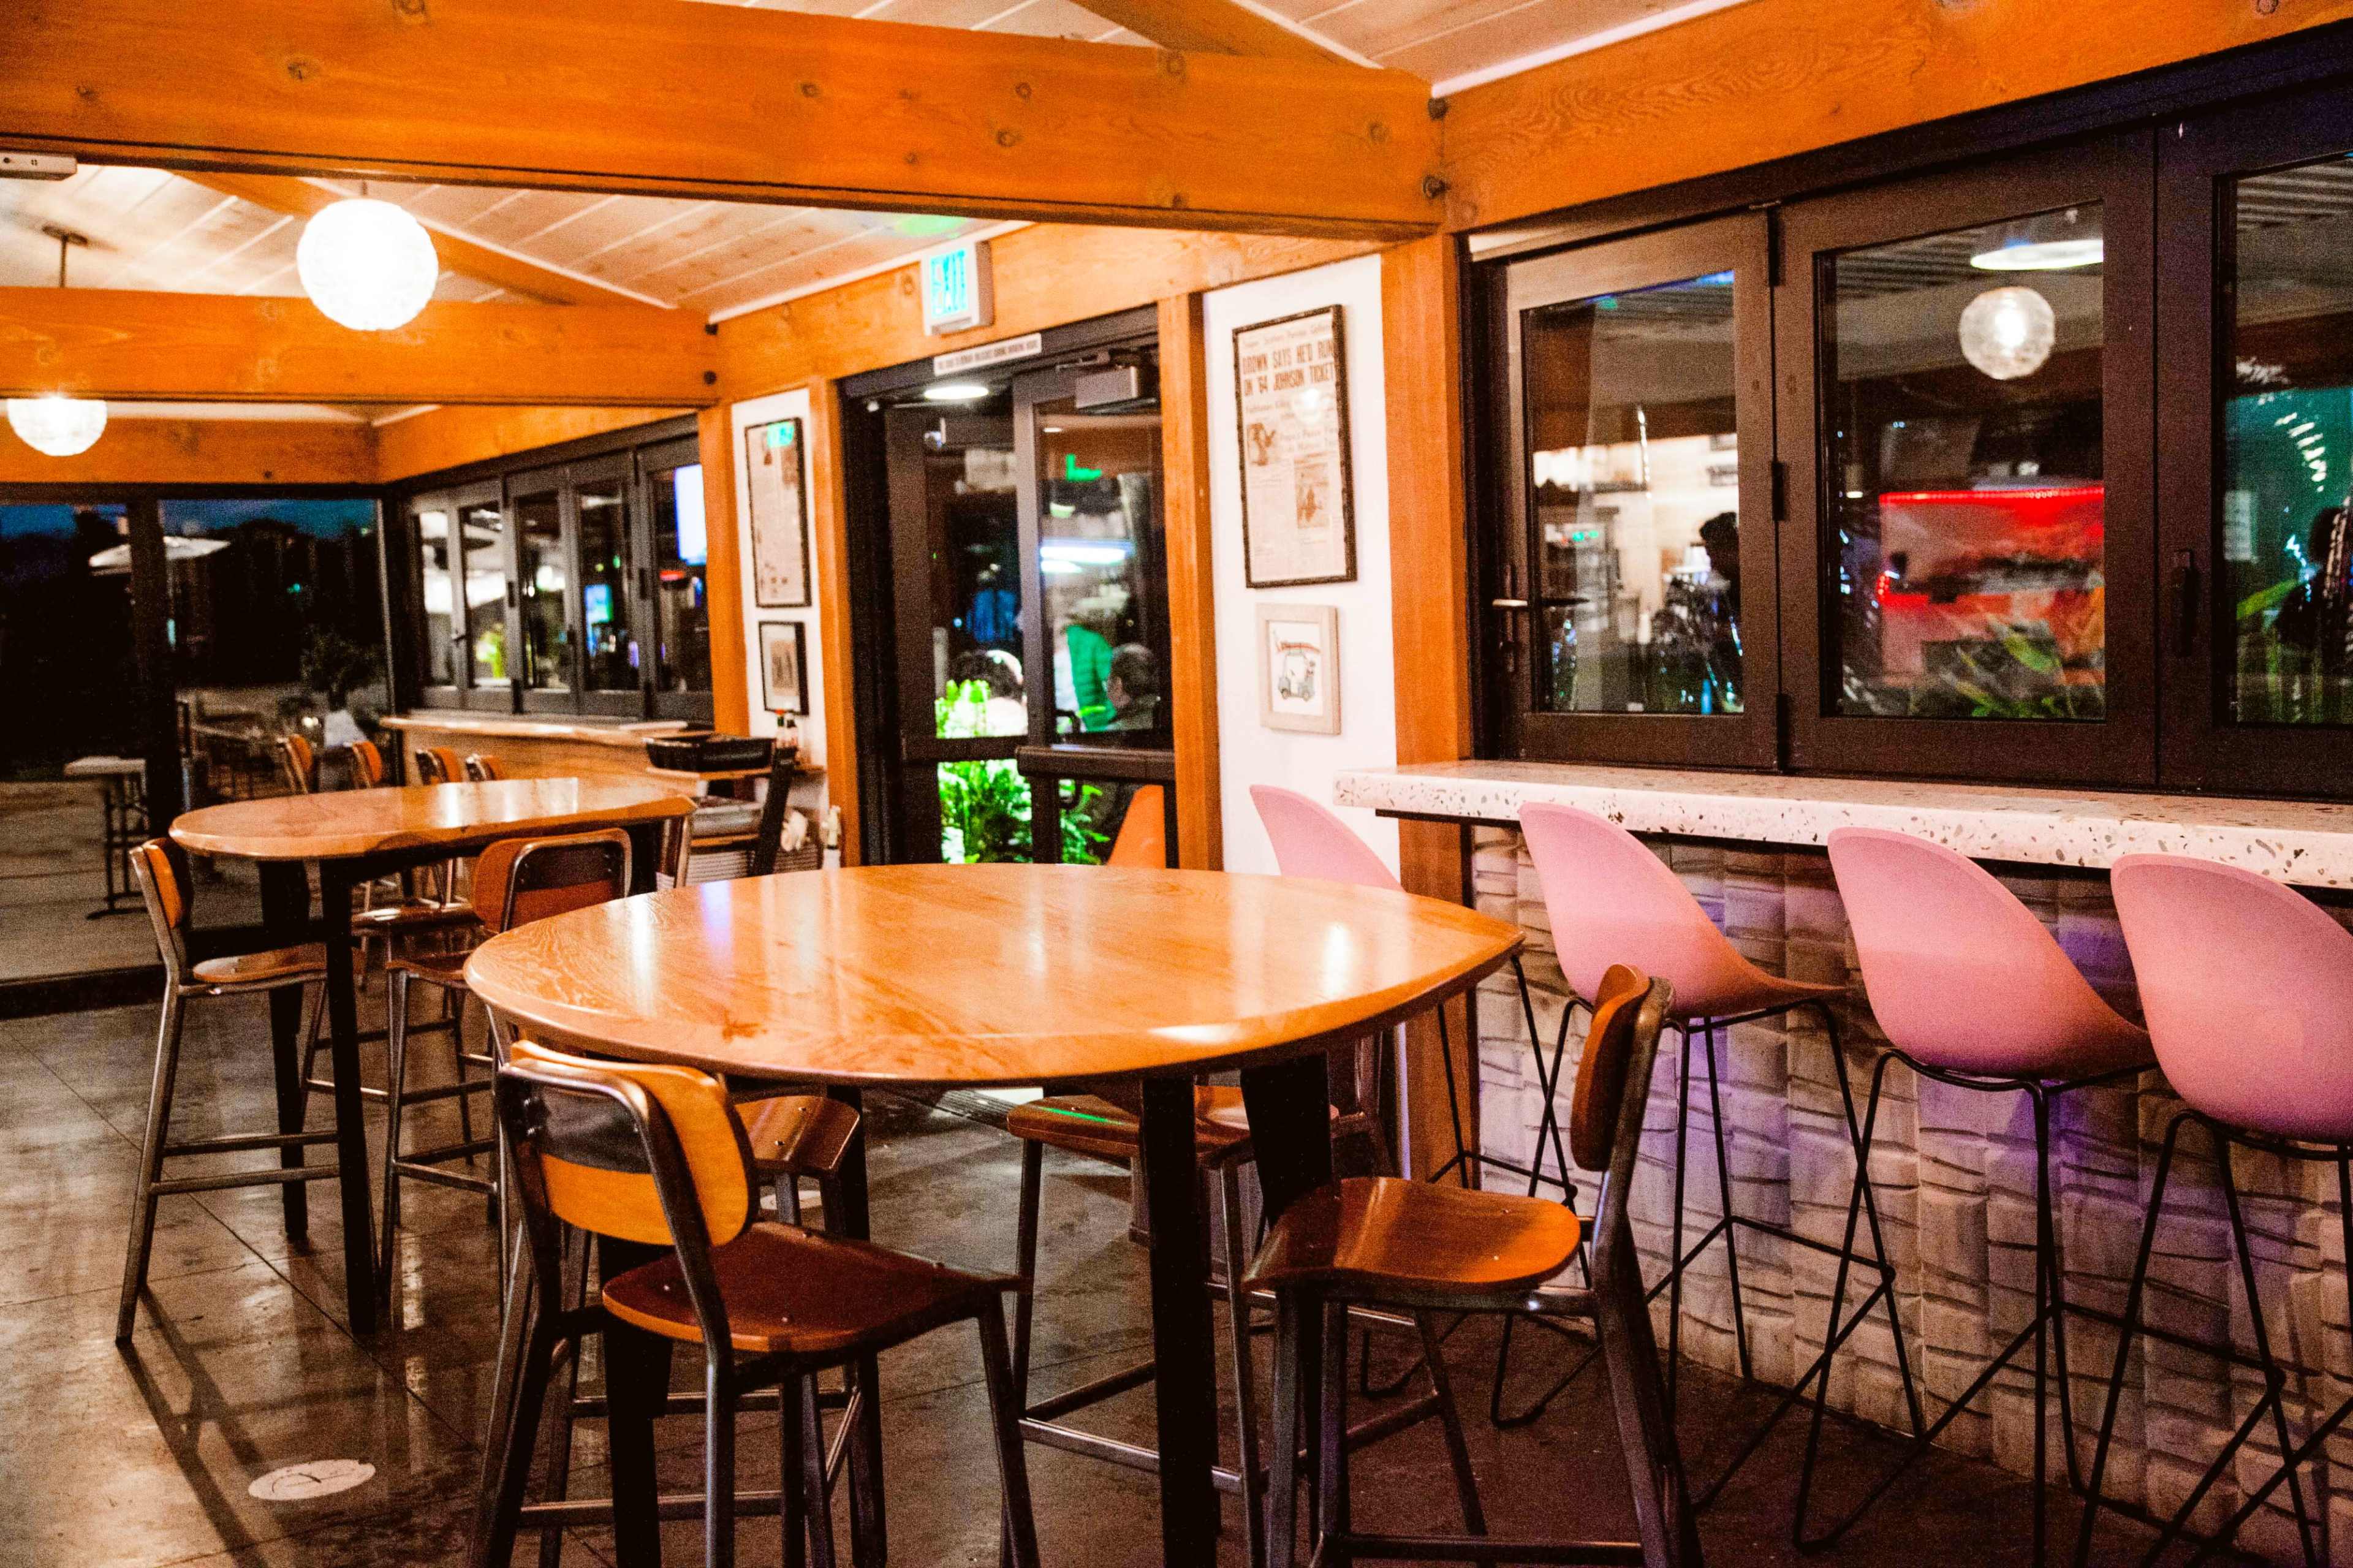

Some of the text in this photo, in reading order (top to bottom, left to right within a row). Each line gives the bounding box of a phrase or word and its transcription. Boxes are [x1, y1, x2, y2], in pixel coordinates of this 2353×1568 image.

[931, 250, 966, 316] EXIT
[1243, 354, 1267, 374] BROWN
[1273, 348, 1291, 368] SAYS
[1274, 368, 1304, 391] JOHNSON
